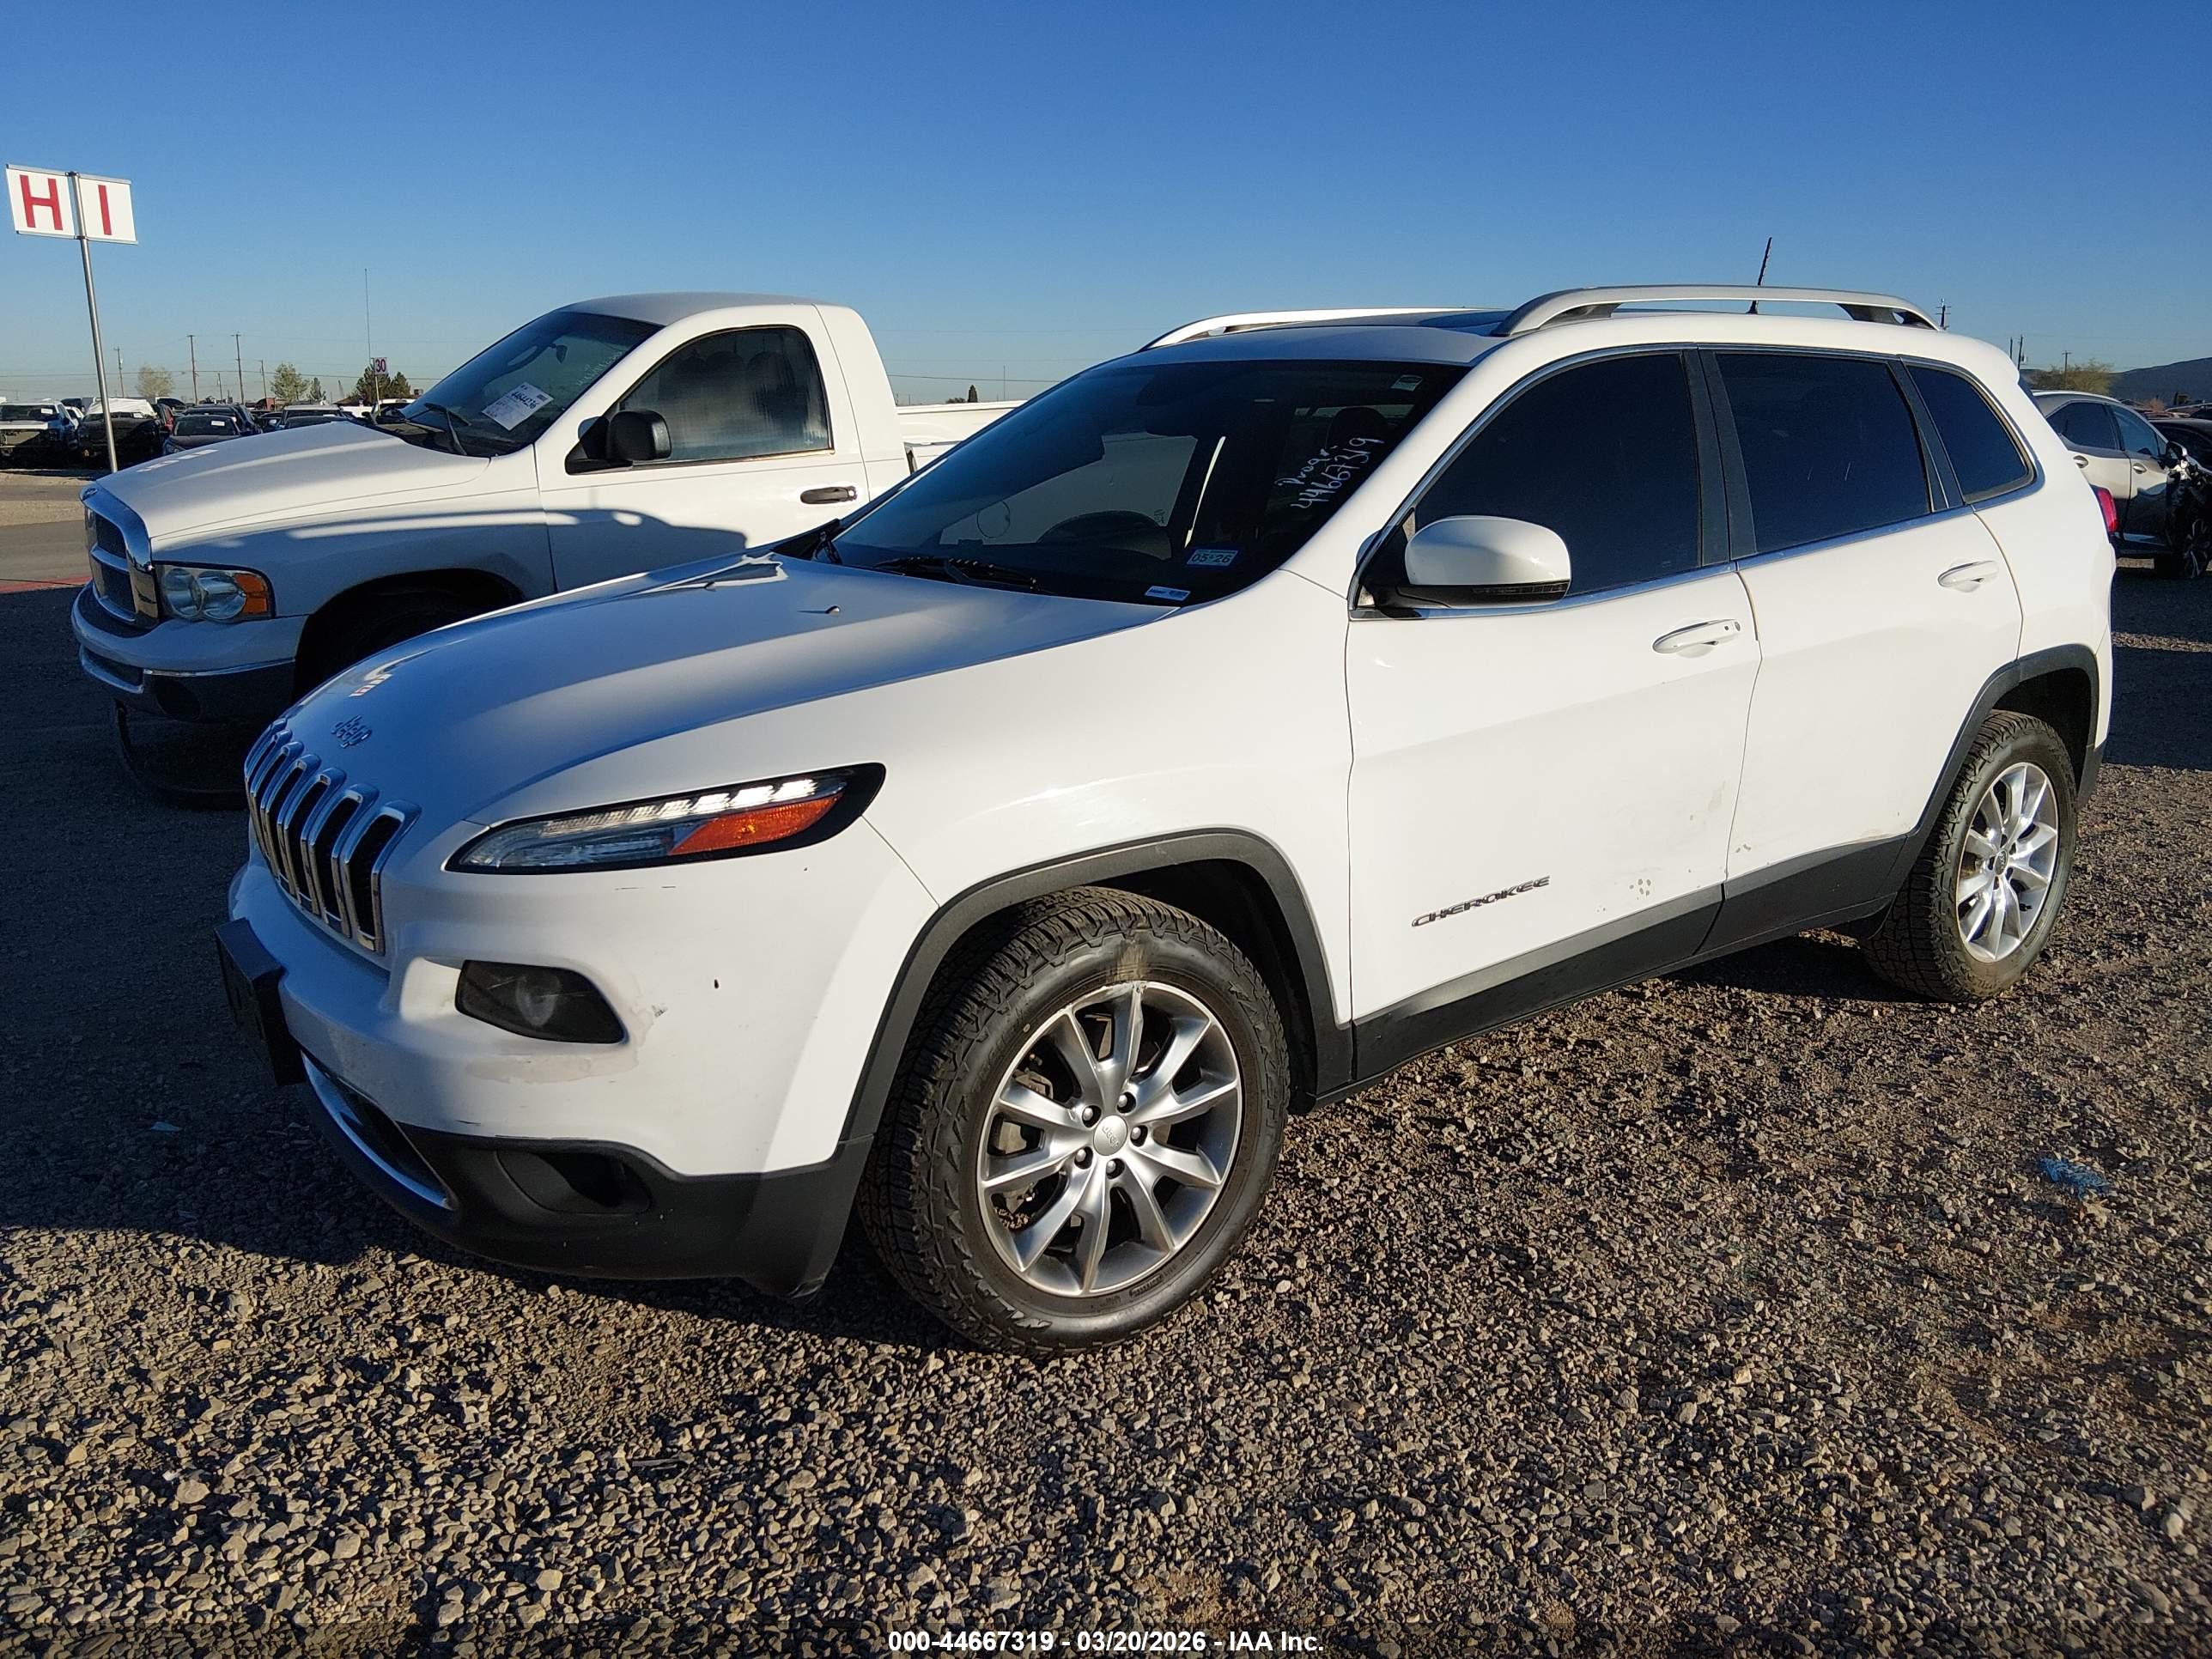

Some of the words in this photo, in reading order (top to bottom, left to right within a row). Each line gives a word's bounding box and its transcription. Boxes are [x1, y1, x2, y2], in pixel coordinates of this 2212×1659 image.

[19, 174, 64, 231] H
[375, 358, 386, 372] 30
[1290, 437, 1385, 508] 44667319
[1191, 553, 1210, 563] 05
[1213, 554, 1232, 563] 26
[1411, 875, 1550, 927] CHEROKEE
